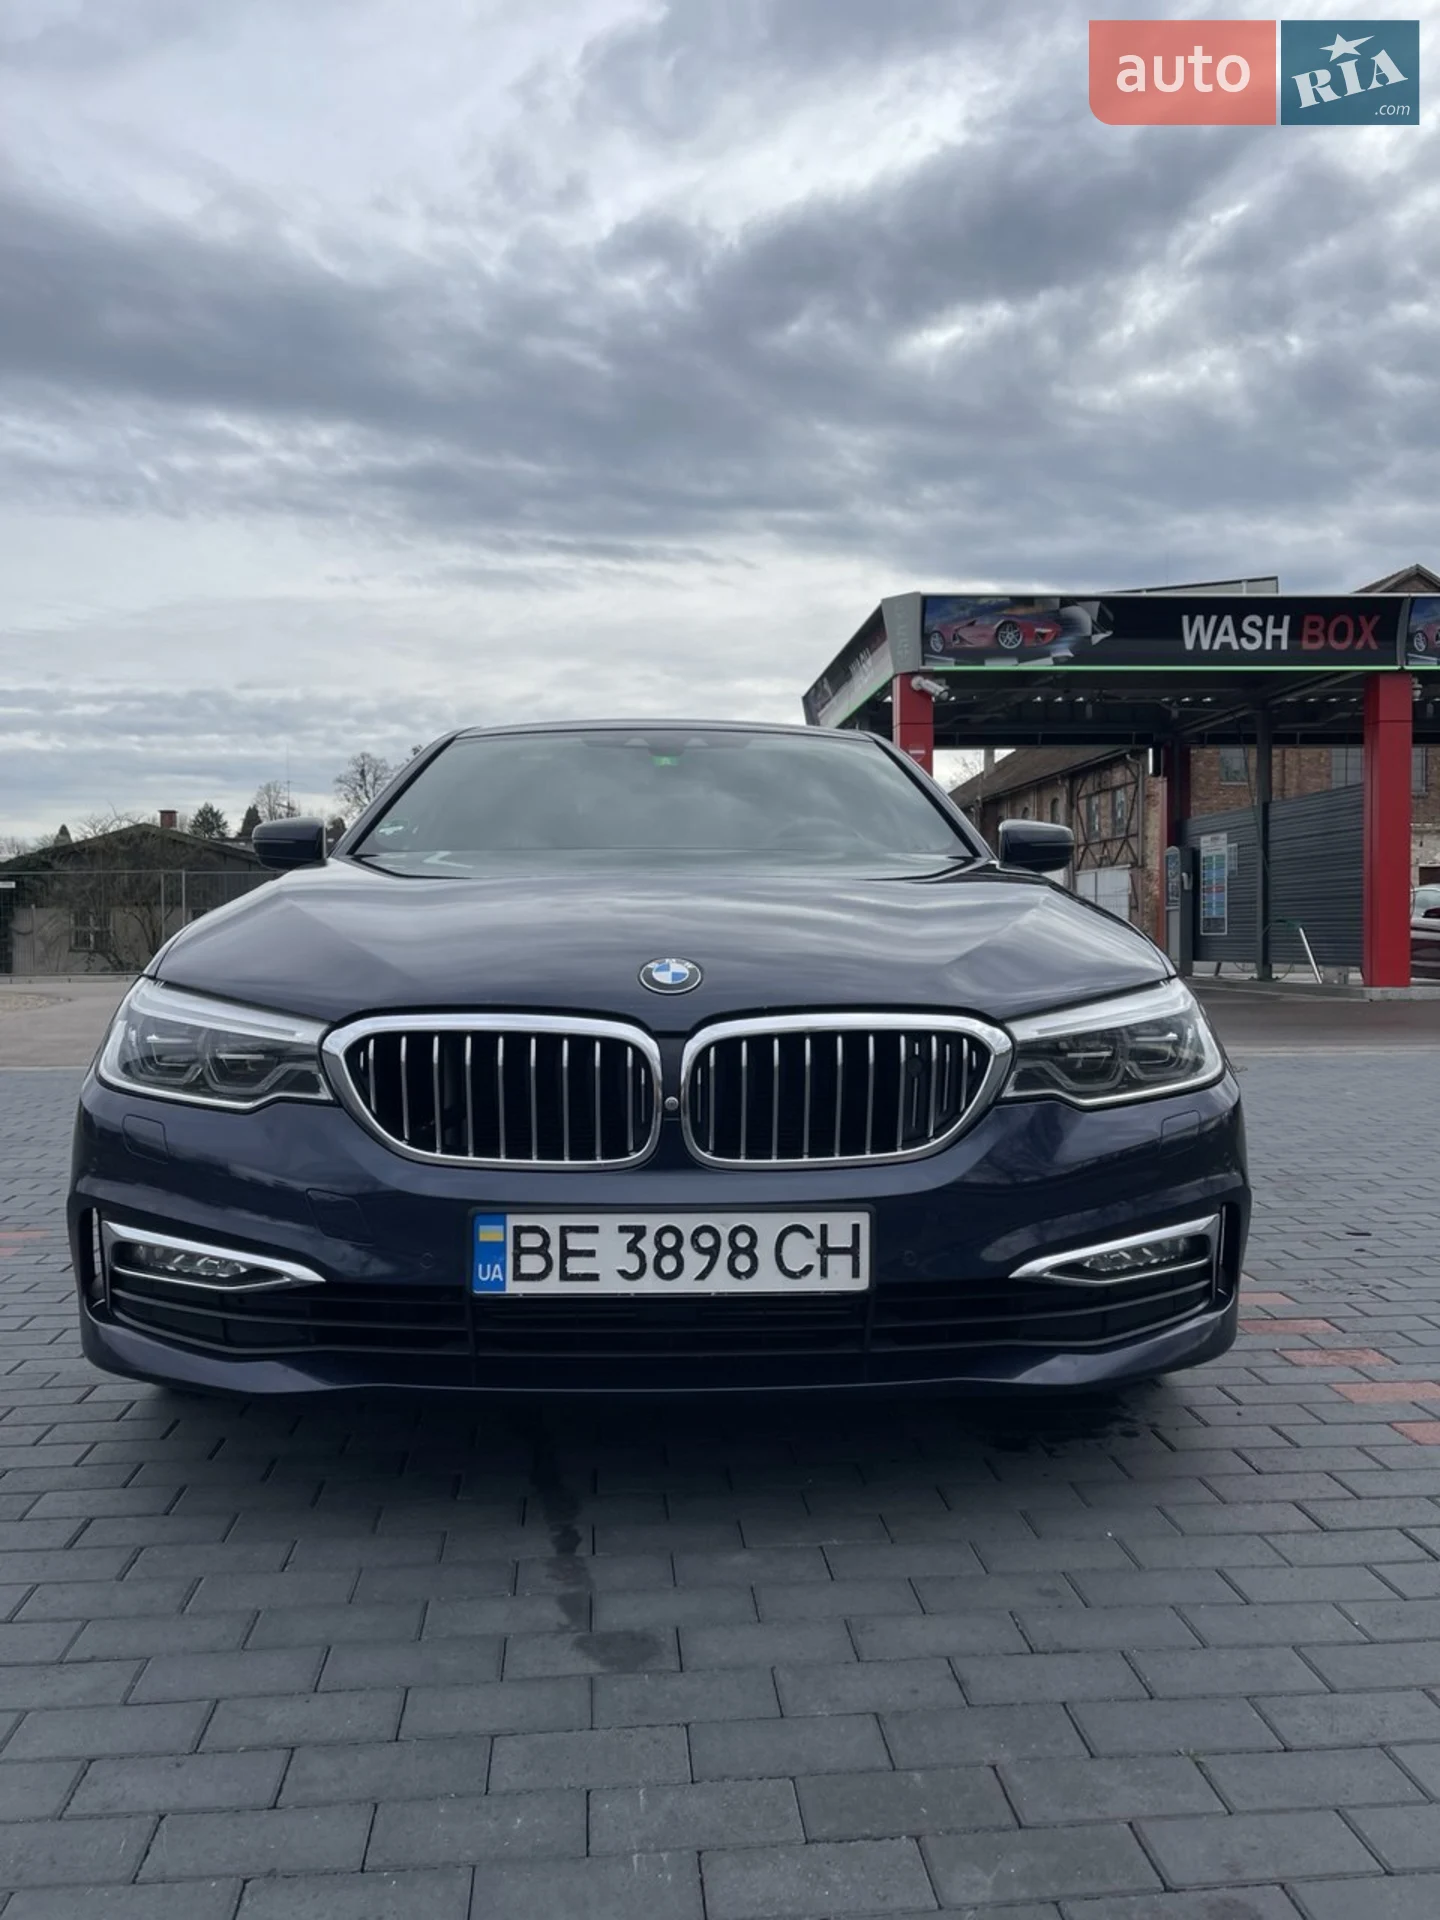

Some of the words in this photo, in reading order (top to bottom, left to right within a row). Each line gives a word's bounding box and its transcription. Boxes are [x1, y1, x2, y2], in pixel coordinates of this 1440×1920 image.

[1181, 614, 1291, 651] WASH
[1301, 614, 1381, 651] BOX
[512, 1224, 601, 1282] BE
[616, 1223, 759, 1282] 3898
[774, 1222, 861, 1281] CH
[477, 1263, 504, 1282] UA
